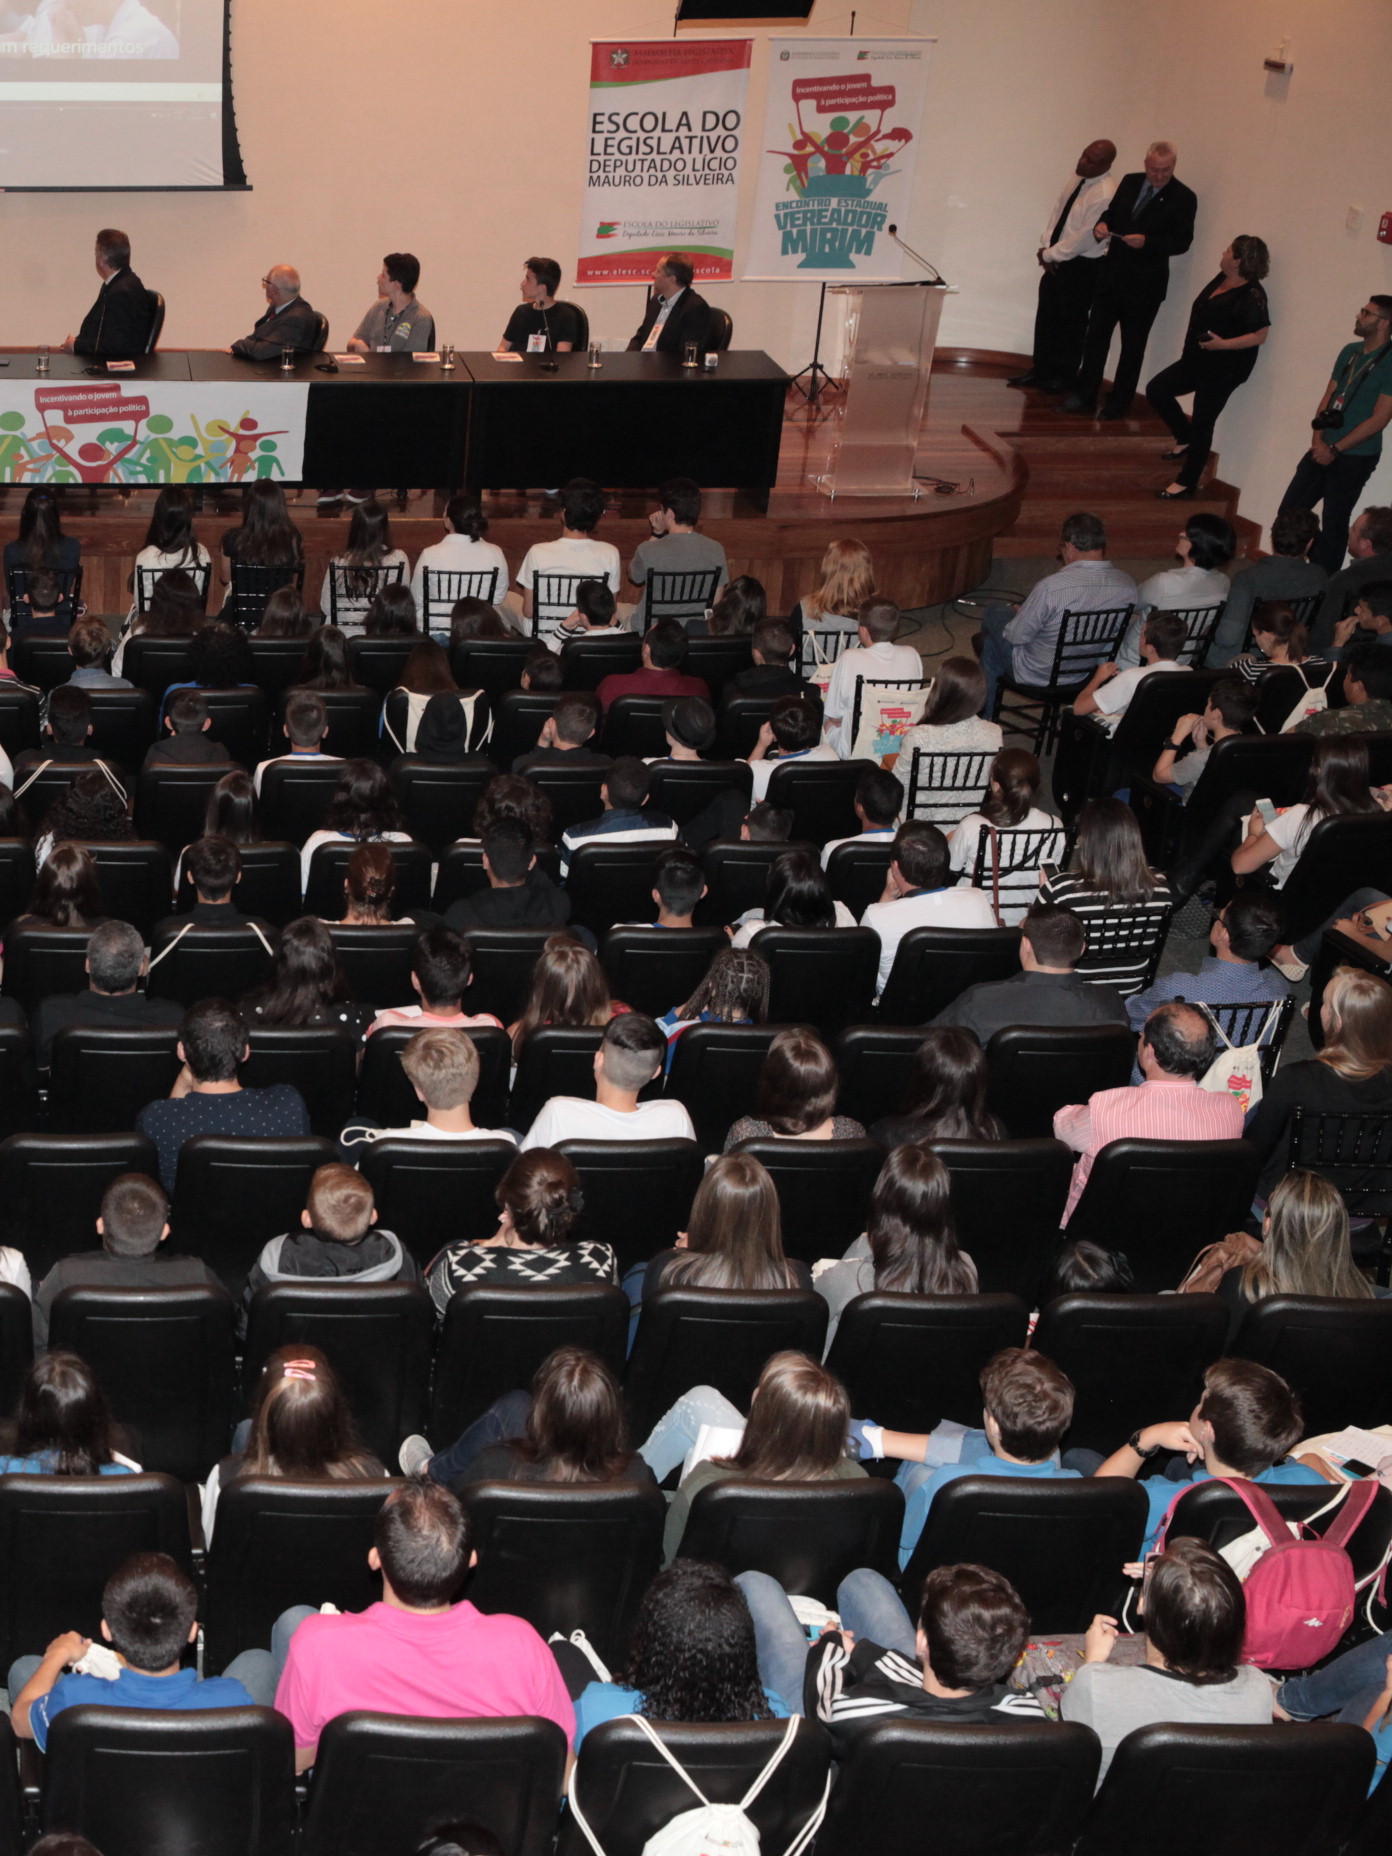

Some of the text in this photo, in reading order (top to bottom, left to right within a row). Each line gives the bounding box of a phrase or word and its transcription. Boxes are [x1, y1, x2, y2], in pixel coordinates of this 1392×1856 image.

[23, 38, 144, 57] requerimentos
[796, 83, 840, 94] Incentivando
[846, 81, 868, 92] jovem
[591, 110, 741, 134] ESCOLA DO
[590, 134, 739, 156] LEGISLATIVO
[589, 154, 737, 174] DEPUTADO LÍCIO
[588, 172, 735, 187] MAURO DA SILVEIRA
[775, 199, 889, 213] ENCONTRO ESTADUAL
[774, 208, 887, 232] VEREADOR
[781, 227, 876, 256] MIRIM
[40, 392, 87, 403] Incentivando
[94, 392, 117, 402] jovem
[73, 405, 118, 416] participação
[119, 403, 146, 414] política
